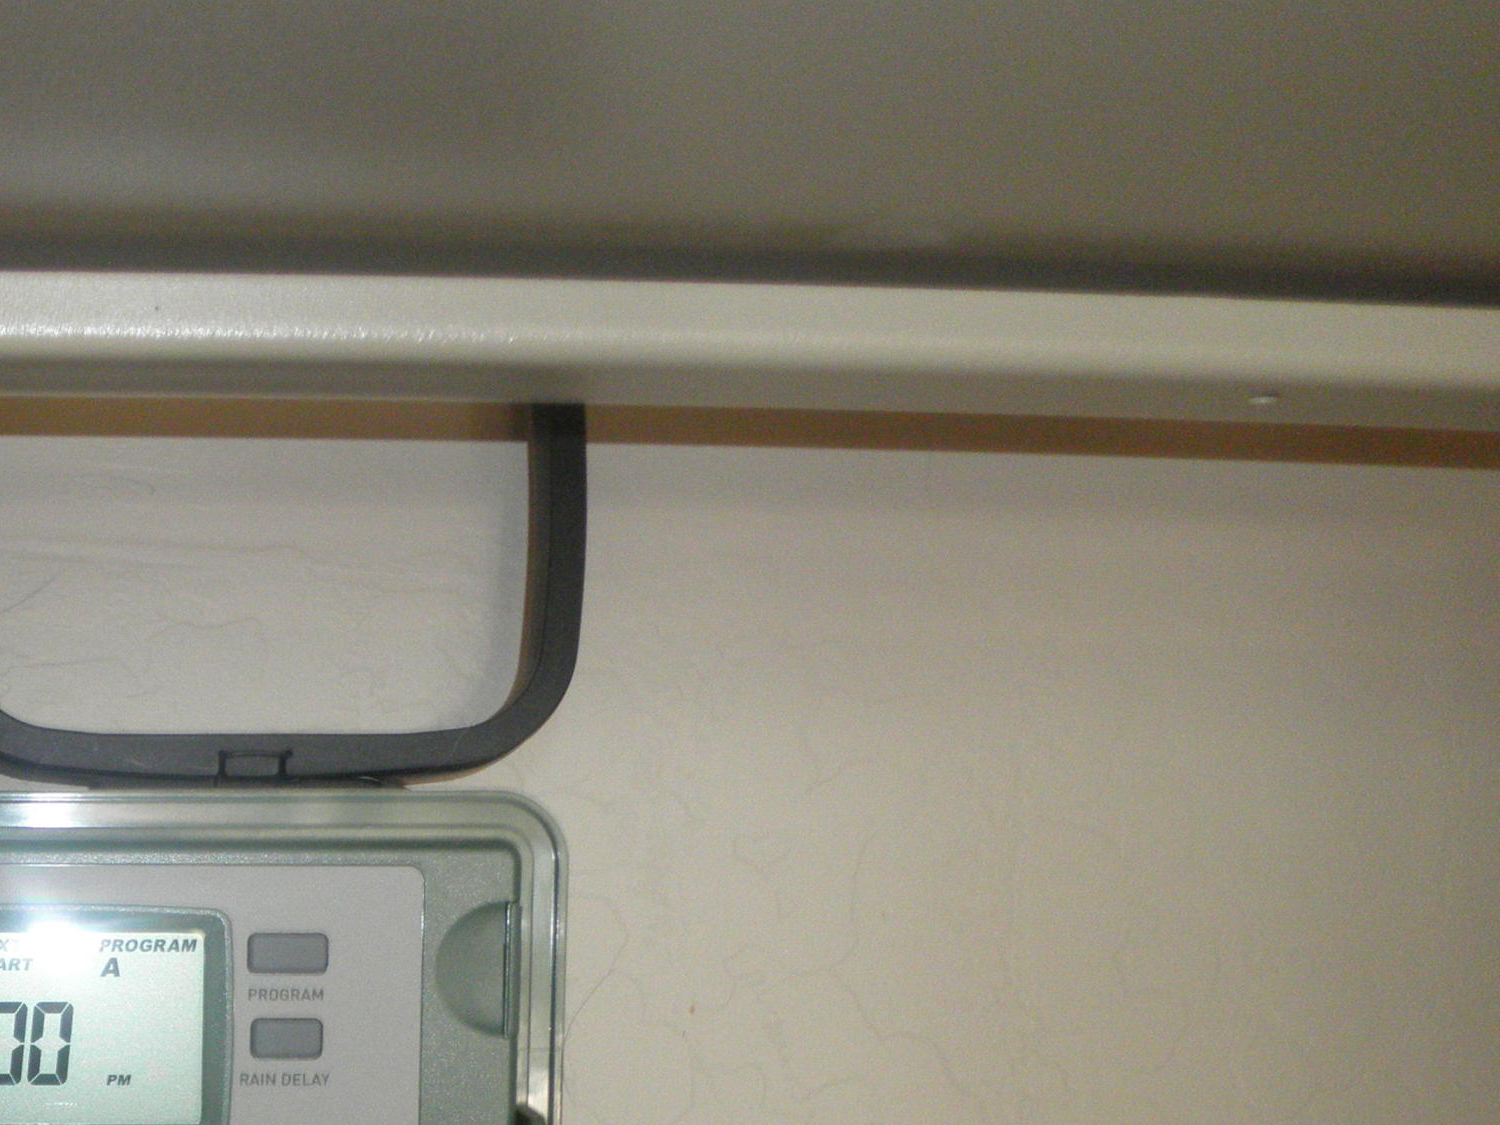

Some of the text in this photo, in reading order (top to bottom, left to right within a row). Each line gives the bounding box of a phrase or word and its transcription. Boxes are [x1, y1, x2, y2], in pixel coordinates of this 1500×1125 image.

[99, 938, 198, 953] PROGRAM
[100, 957, 122, 978] A
[248, 988, 325, 1001] PROGRAM
[106, 1074, 132, 1086] PM
[240, 1072, 330, 1087] RAIN DELAY
